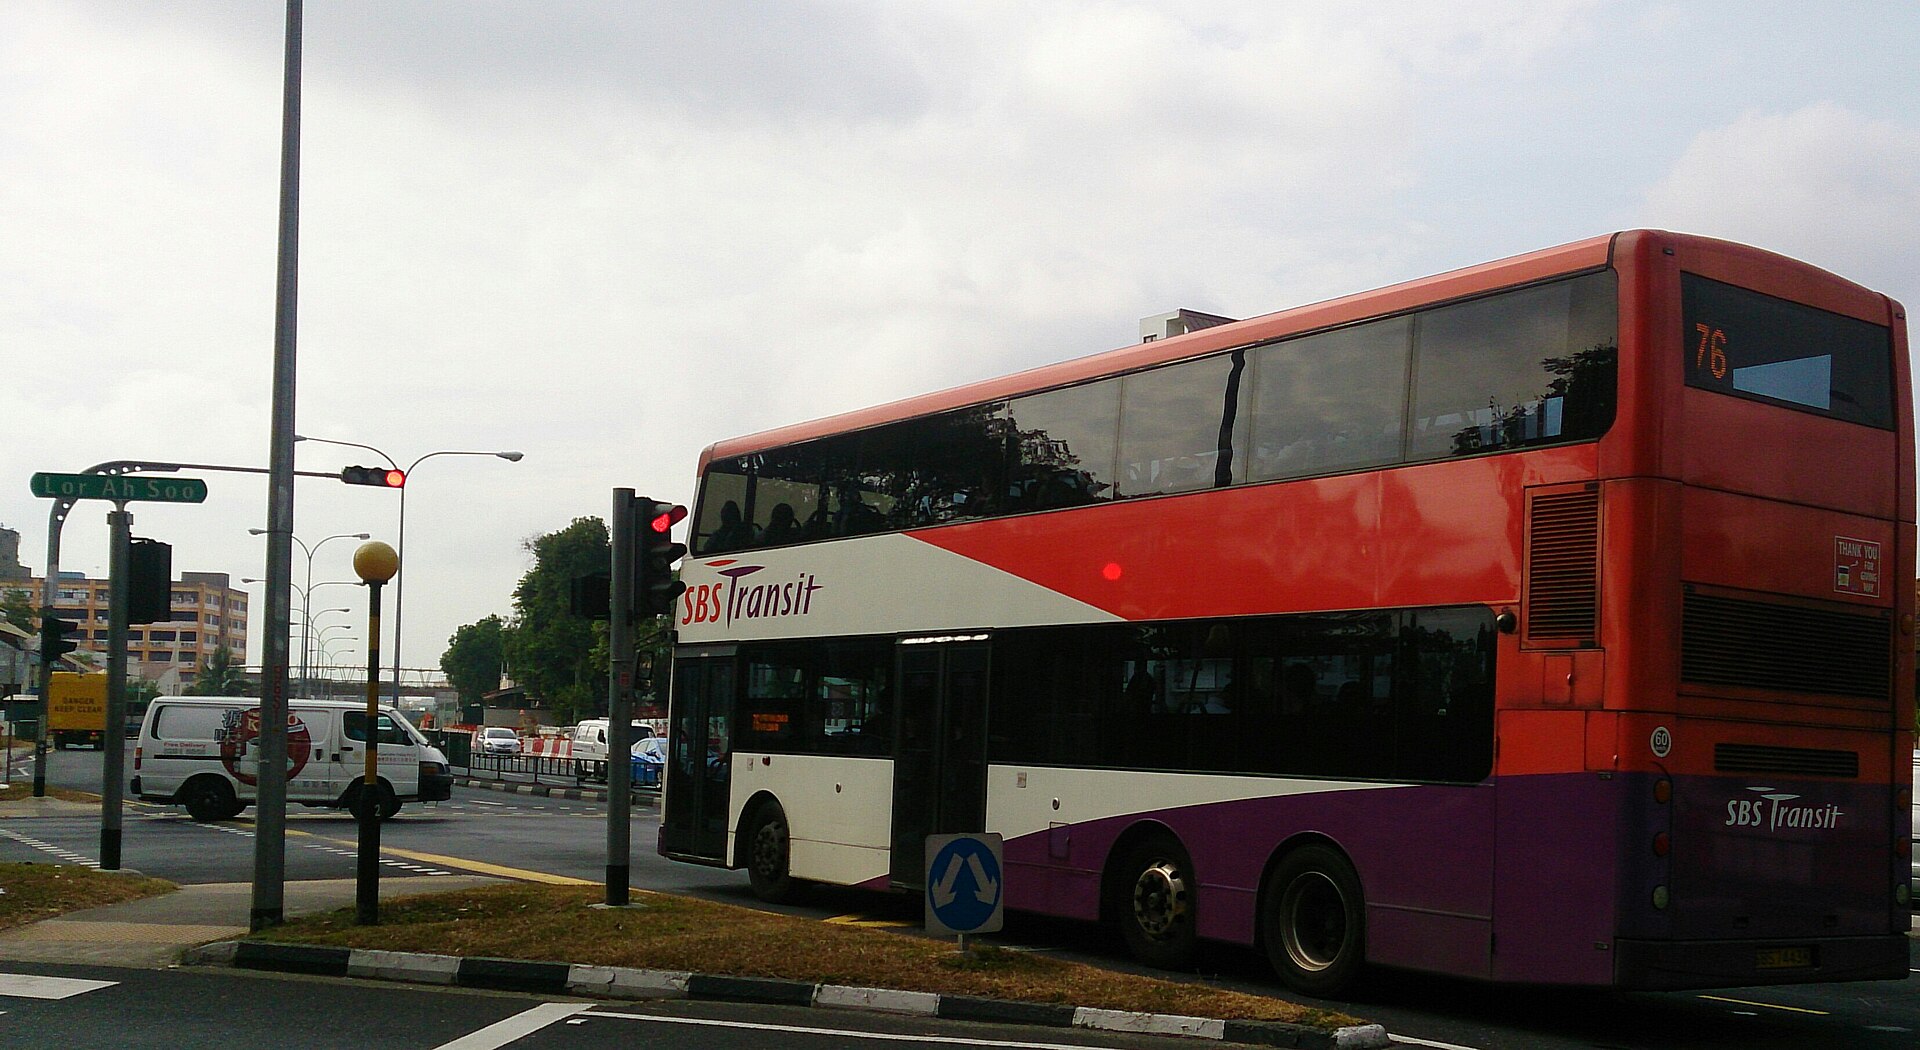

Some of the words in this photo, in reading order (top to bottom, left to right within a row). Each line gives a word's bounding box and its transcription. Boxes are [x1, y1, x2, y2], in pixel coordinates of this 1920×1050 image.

[1695, 322, 1727, 379] 76
[45, 476, 87, 495] Lor
[102, 478, 134, 497] Ah
[147, 479, 194, 499] Soo
[1838, 541, 1862, 558] THANK
[1864, 545, 1878, 560] YOU
[682, 583, 723, 625] SBS
[717, 566, 824, 630] Transit
[54, 705, 75, 713] KEEP
[77, 705, 103, 713] CLEAR
[62, 697, 95, 705] DANGER
[1655, 732, 1668, 746] 60
[374, 804, 381, 817] 2
[1725, 800, 1763, 826] SBS
[1760, 793, 1845, 832] Transit
